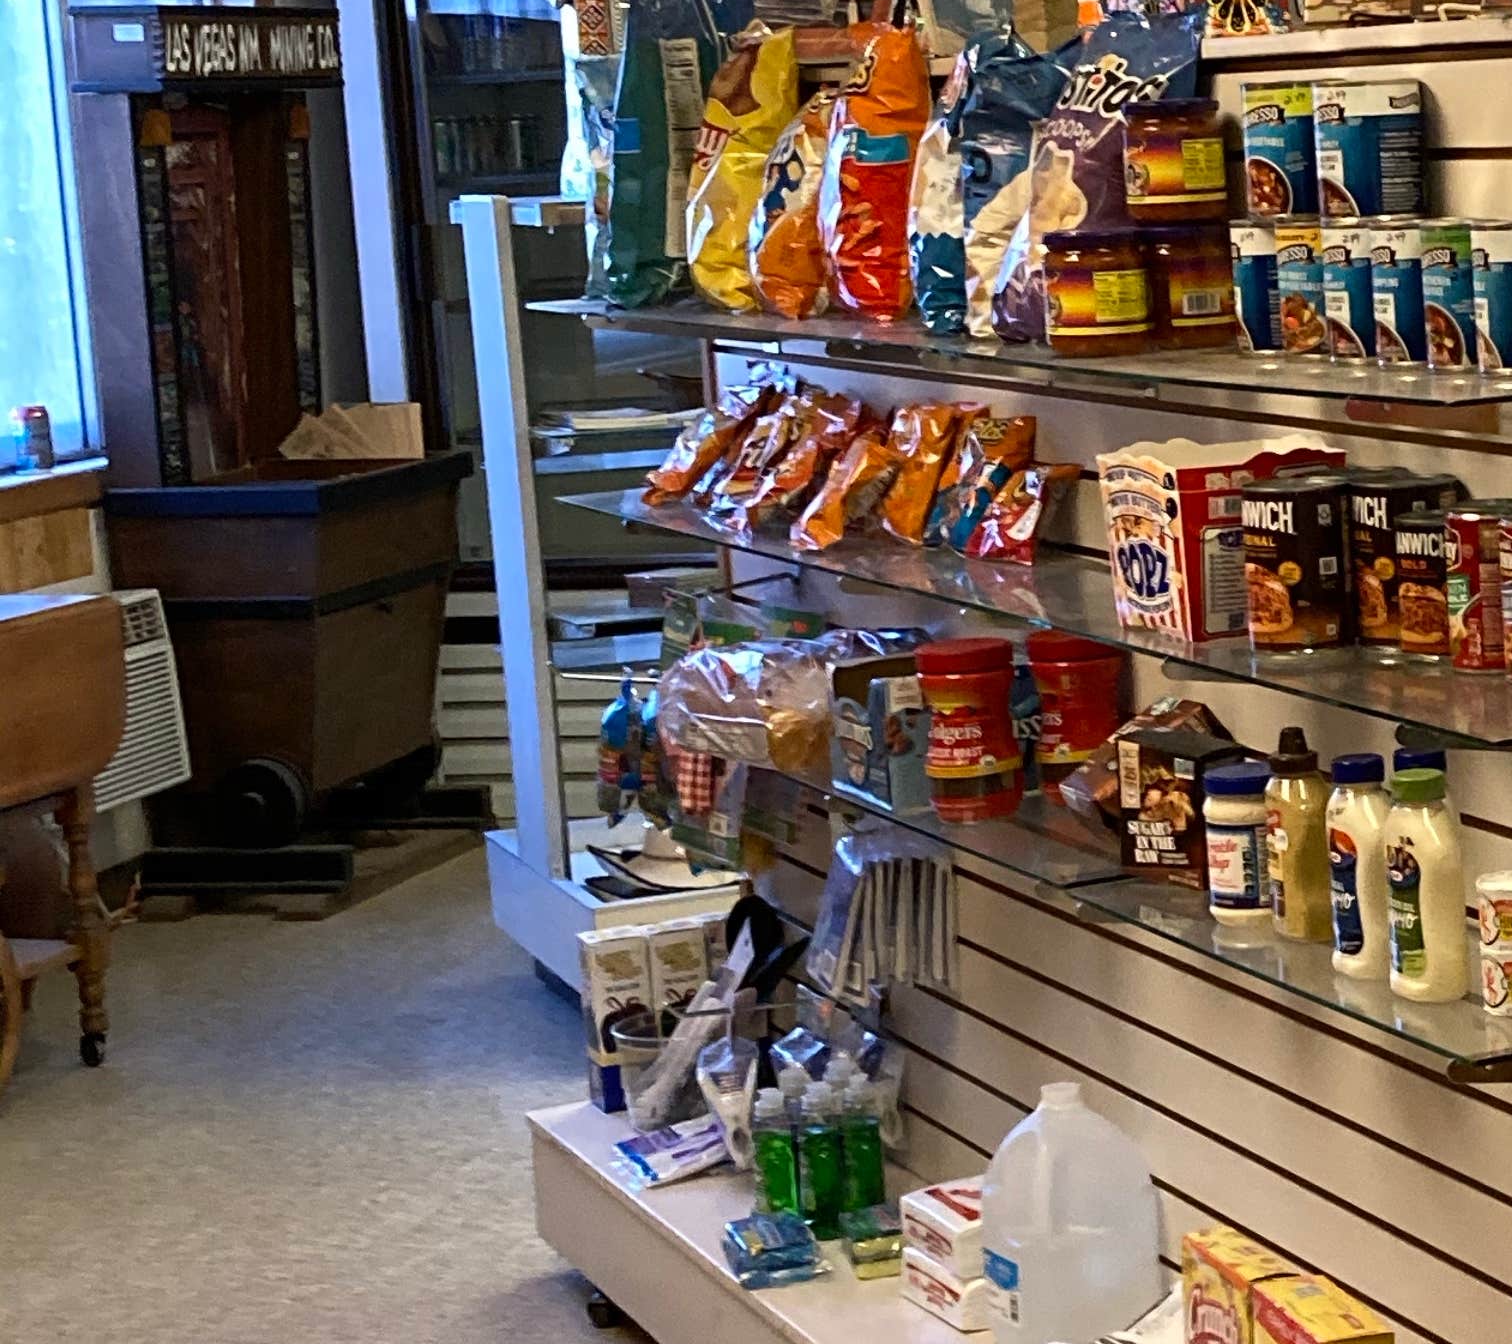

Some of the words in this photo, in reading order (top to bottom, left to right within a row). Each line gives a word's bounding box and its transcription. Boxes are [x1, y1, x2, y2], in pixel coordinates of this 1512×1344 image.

[166, 23, 192, 72] LAS
[193, 22, 236, 77] VEGAS
[1151, 836, 1177, 850] THE
